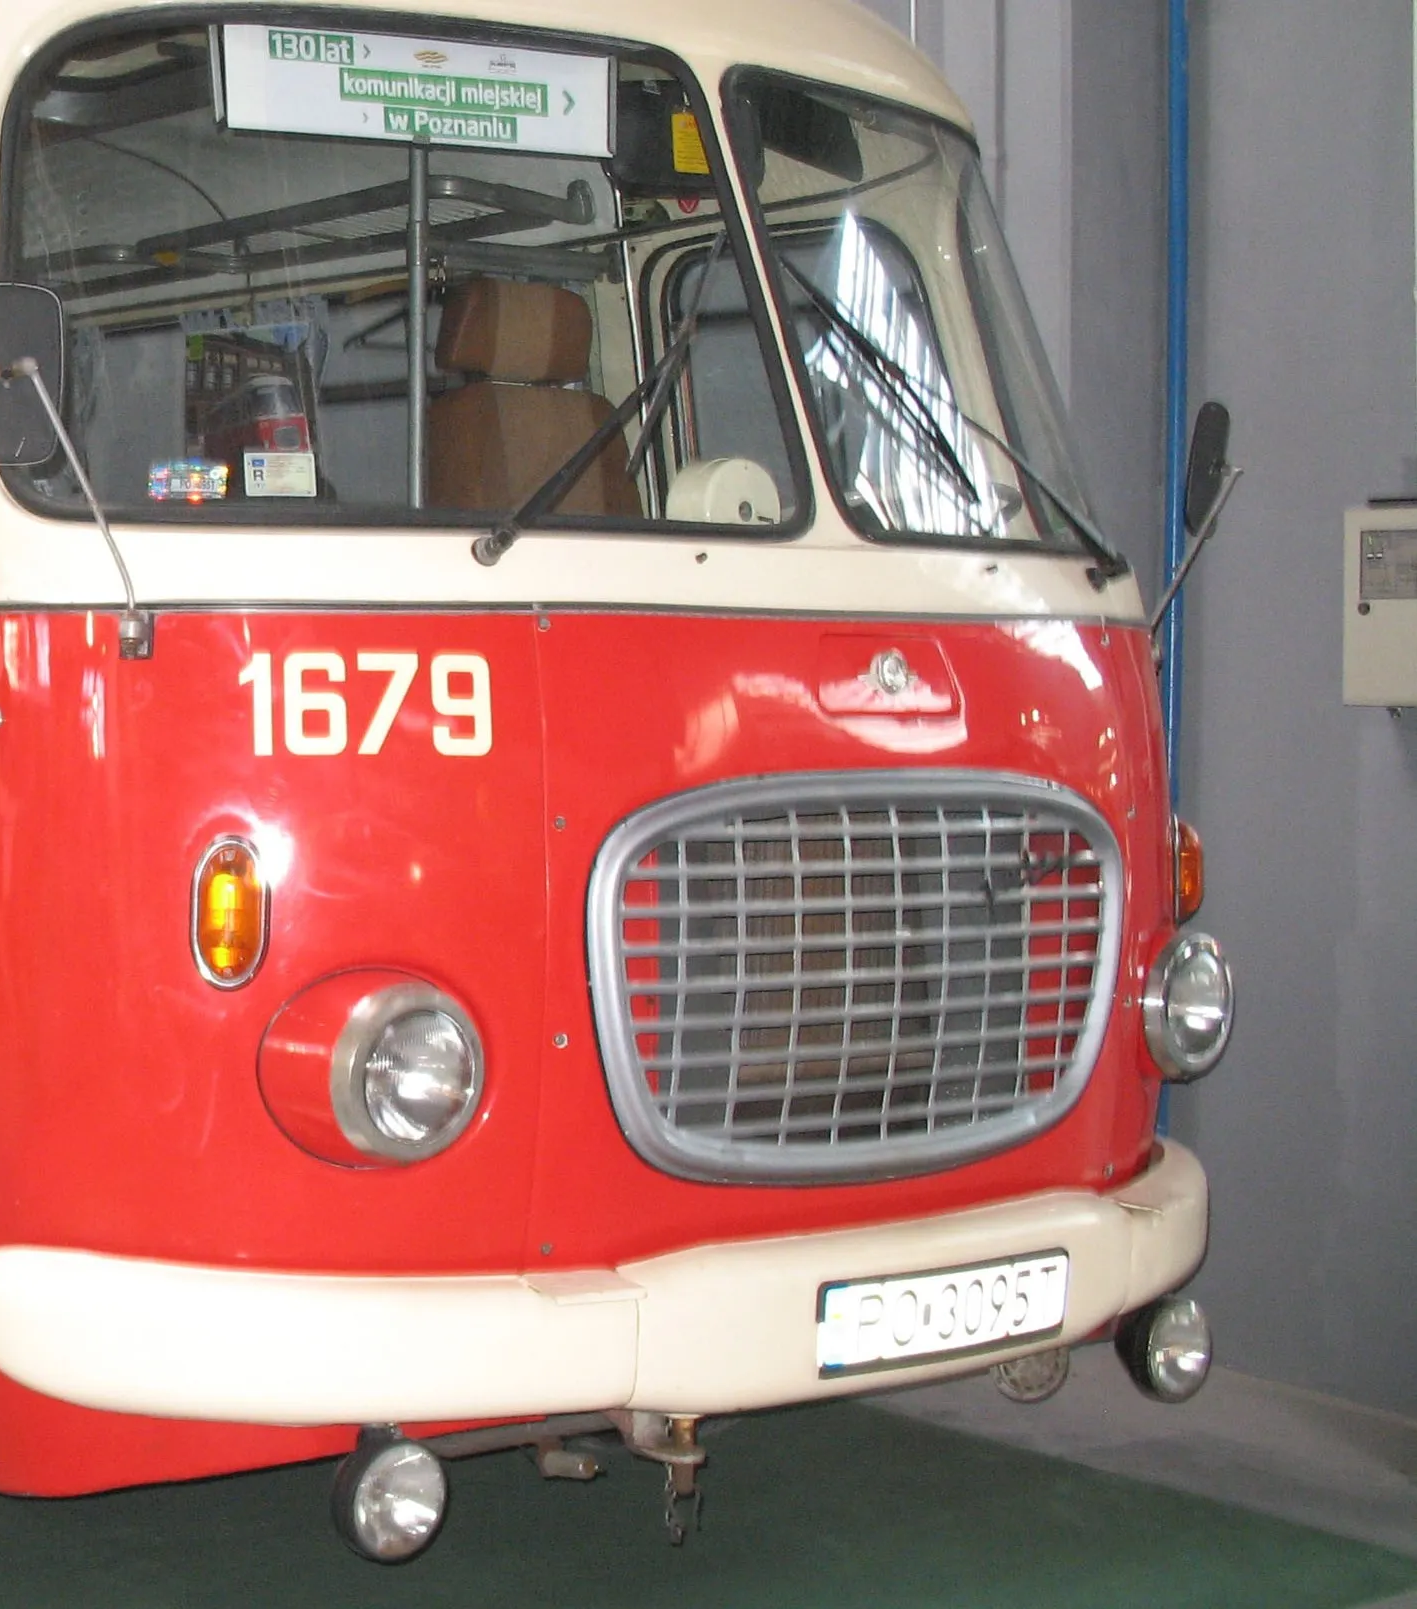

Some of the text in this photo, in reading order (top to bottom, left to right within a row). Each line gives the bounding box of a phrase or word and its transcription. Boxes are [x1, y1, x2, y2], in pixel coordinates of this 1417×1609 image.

[271, 32, 351, 64] 130 lat
[343, 72, 543, 114] komunikacji miejskiej
[388, 111, 512, 140] w Poznaniu
[254, 469, 264, 481] R
[238, 651, 493, 757] 1679
[857, 1263, 1059, 1358] PO 3095T
